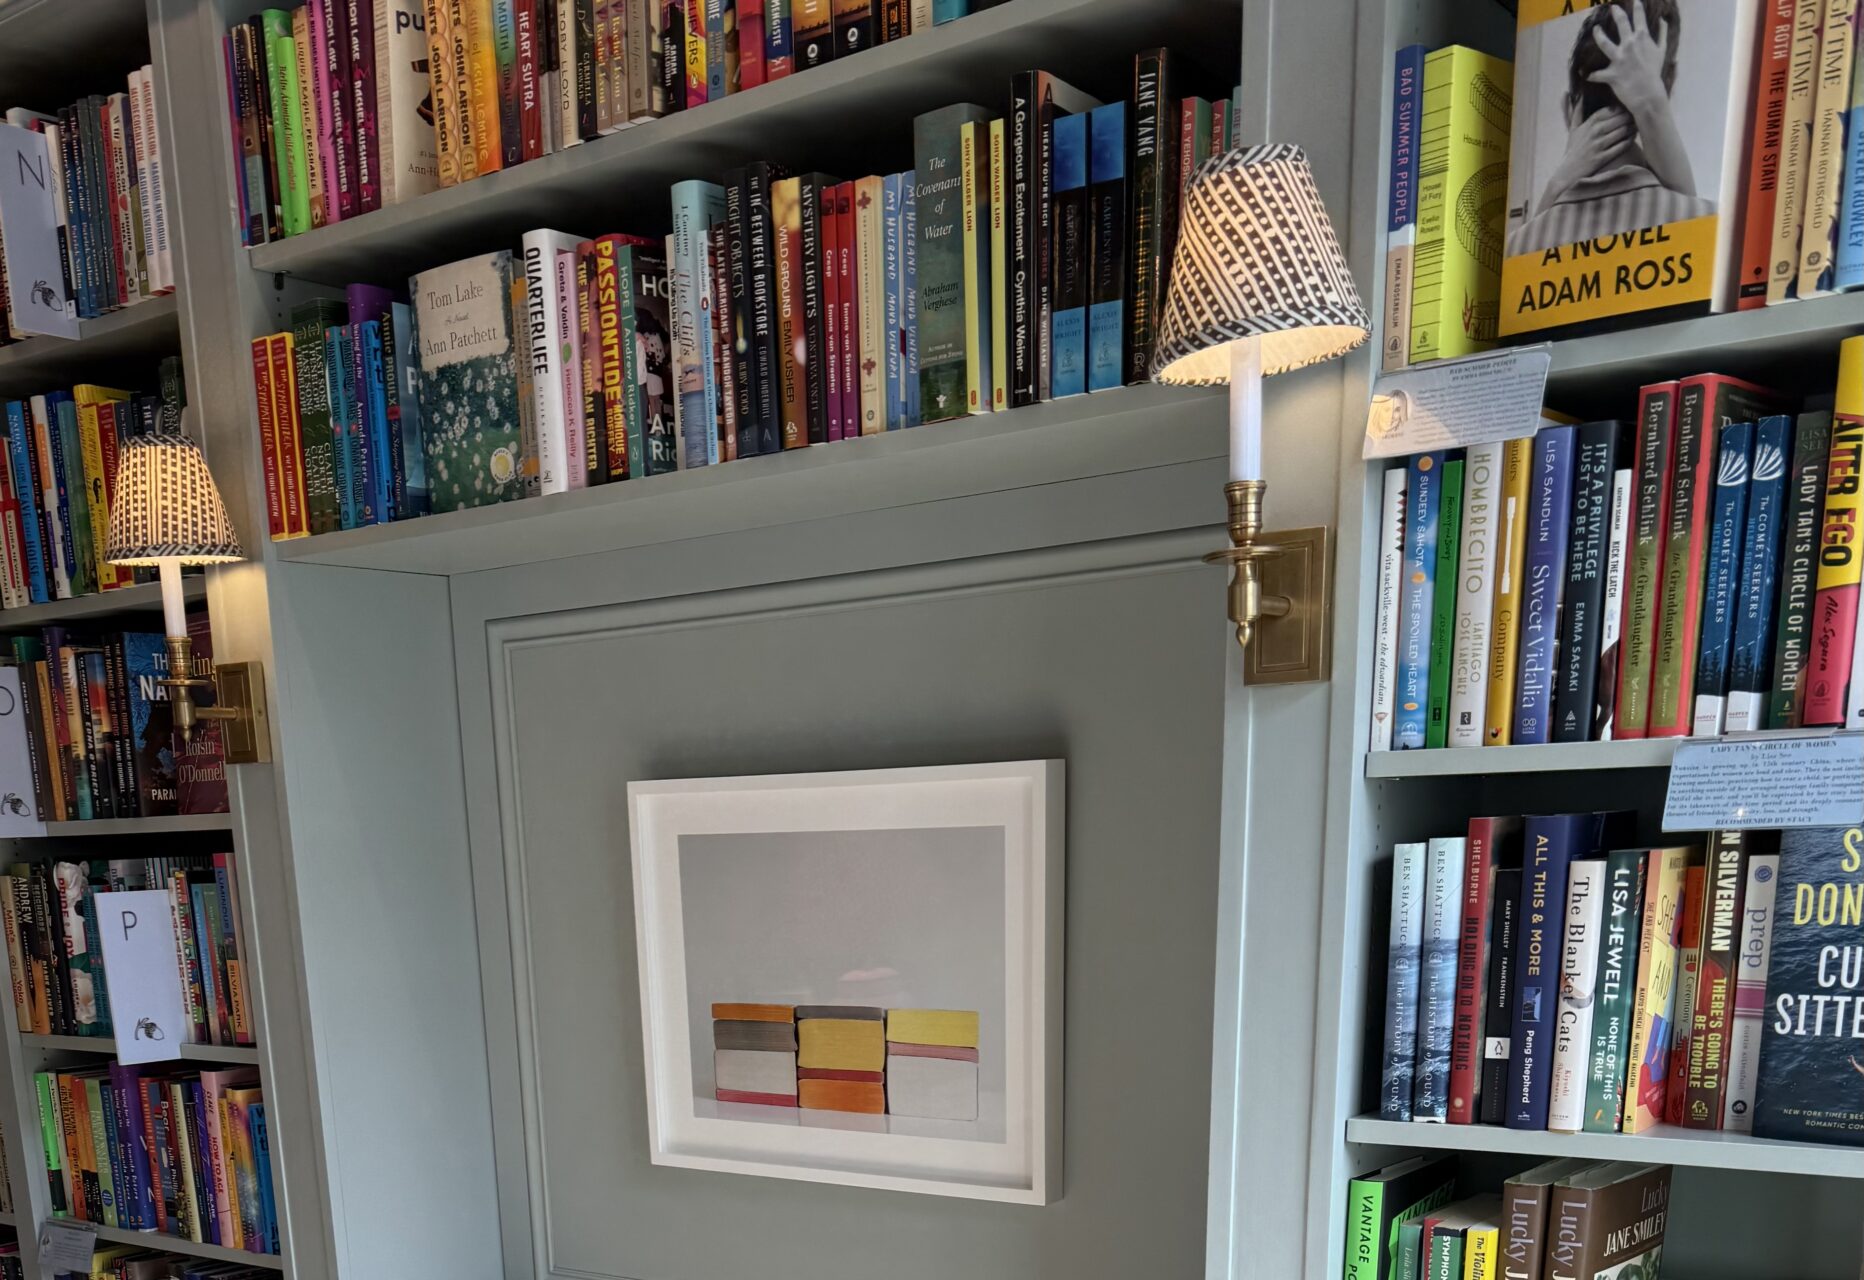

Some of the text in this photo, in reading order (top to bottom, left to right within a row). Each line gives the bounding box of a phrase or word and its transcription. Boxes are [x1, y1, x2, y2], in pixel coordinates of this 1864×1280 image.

[517, 11, 534, 110] HEART SUTRA
[431, 45, 449, 152] JOHN LARISON
[1137, 70, 1156, 158] JANE YANG
[1760, 25, 1790, 191] ROTH THE HUMAN STAIN
[18, 150, 45, 190] N
[916, 157, 961, 198] The Covenant
[1015, 111, 1027, 180] Gorgeous
[1394, 67, 1414, 224] BAD SUMMER PEOPLE
[802, 185, 815, 257] MYSTERY
[925, 201, 953, 239] of Water
[1015, 182, 1027, 262] Excitement
[1543, 226, 1670, 266] A NOVEL
[427, 281, 484, 309] Tom Lake
[577, 262, 590, 333] THE DIVIDE
[620, 266, 629, 308] HOPE
[777, 224, 792, 318] WILD GROUND
[804, 263, 817, 319] LIGHTS
[922, 282, 959, 298] Abraham
[923, 294, 958, 311] Verghese
[1517, 253, 1693, 314] ADAM ROSS
[426, 325, 497, 356] Ann Patchett
[525, 247, 548, 376] QUARTERLIFE
[596, 240, 621, 402] PASSIONTIDE
[1594, 442, 1608, 474] IT'S
[1820, 412, 1864, 567] ALTER EGO
[1465, 453, 1491, 594] HOMBRECITO
[1570, 444, 1593, 582] JUST TO BE HERE
[1584, 495, 1603, 580] PRIVILEGE
[1631, 400, 1664, 668] Bernhard Schlink the Granddaughter
[1522, 440, 1556, 710] LISA SANDLIN Sweet Vidalia
[1780, 464, 1819, 692] LADY TAN'S CIRCLE OF WOMEN
[178, 763, 227, 784] O'Donnell
[1711, 744, 1731, 753] LADY
[1760, 743, 1789, 751] CIRCLE
[18, 877, 33, 924] ANDREW
[121, 910, 138, 941] P
[216, 870, 231, 929] LUMINOUS
[1527, 835, 1549, 977] ALL THIS & MORE
[1603, 869, 1631, 1000] LISA JEWELL
[1710, 851, 1739, 952] SILVERMAN
[1455, 839, 1482, 1071] SHELBURNE HOLDING ON TO NOTHING
[1558, 877, 1591, 1053] The Blanket Cats
[1741, 907, 1768, 970] prep
[1688, 1014, 1707, 1088] BE TROUBLE
[1702, 976, 1728, 1089] THERE'S GOING TO
[1359, 1194, 1374, 1264] VANTAGE
[1476, 1238, 1484, 1248] The
[1503, 1198, 1537, 1263] Lucky
[1551, 1200, 1587, 1269] Lucky
